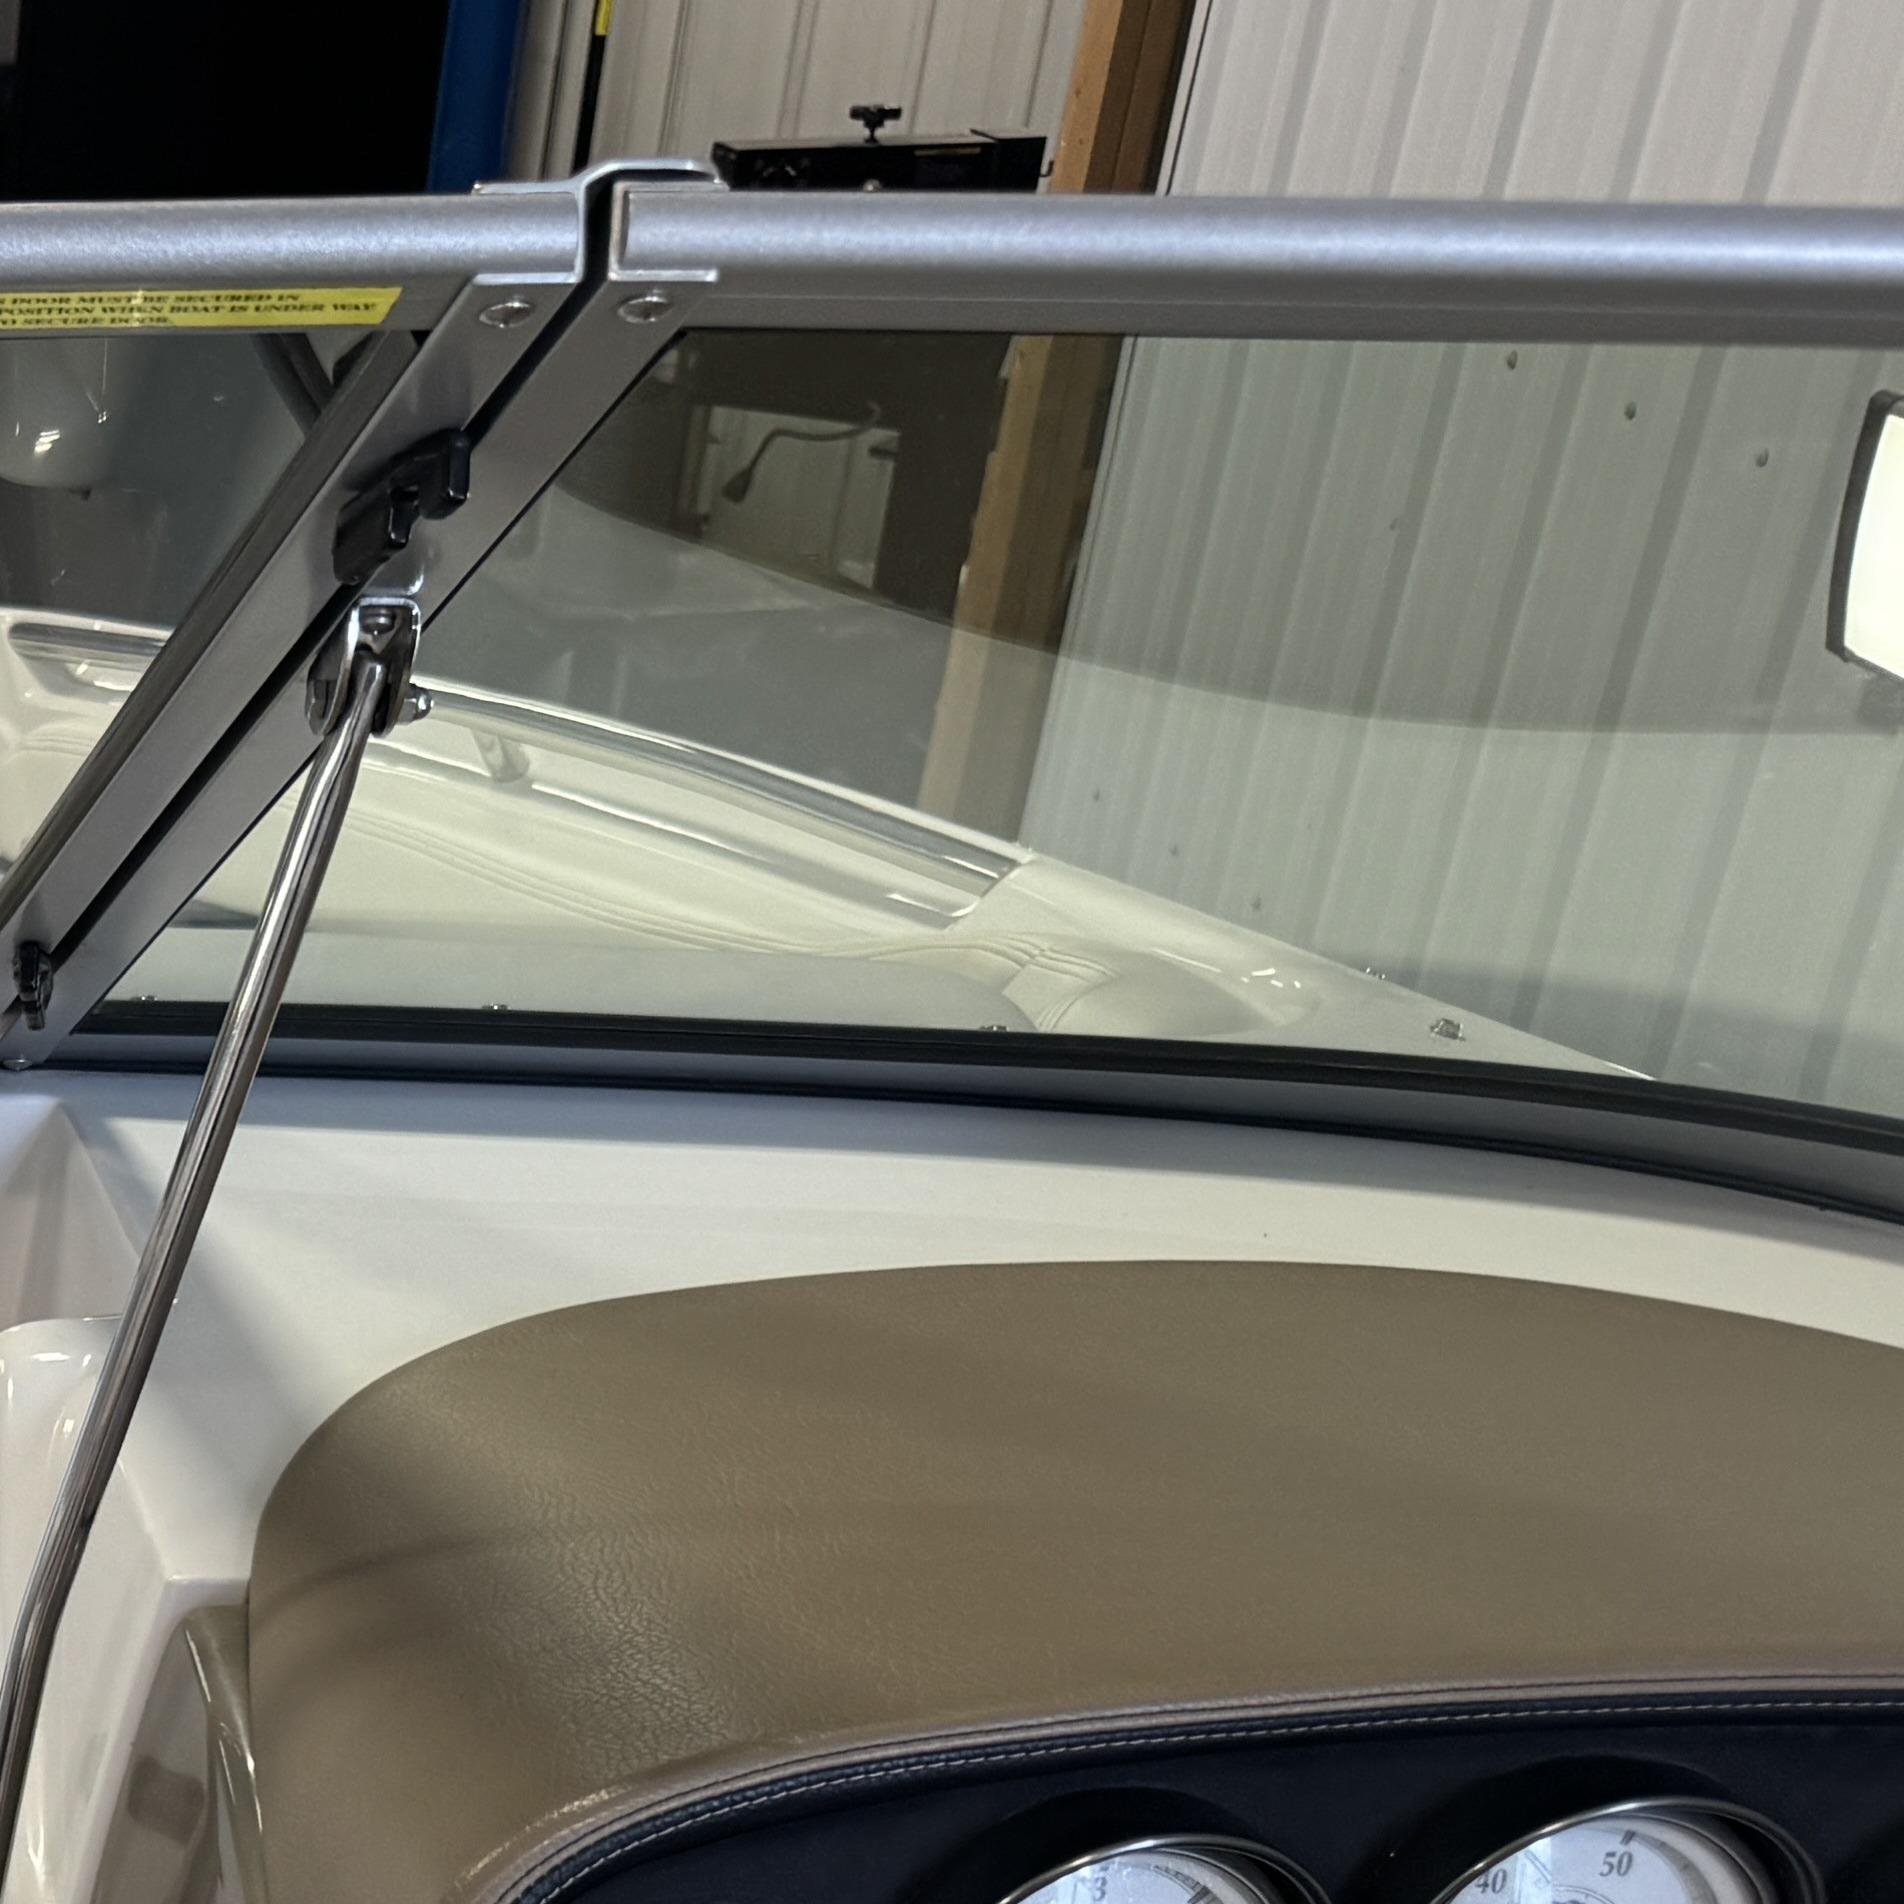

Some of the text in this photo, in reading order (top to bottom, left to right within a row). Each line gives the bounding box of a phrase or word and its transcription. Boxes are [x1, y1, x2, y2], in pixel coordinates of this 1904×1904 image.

[170, 305, 225, 313] BOAT
[1599, 1851, 1633, 1877] 50
[1093, 1877, 1108, 1900] 3
[1474, 1868, 1508, 1894] 40
